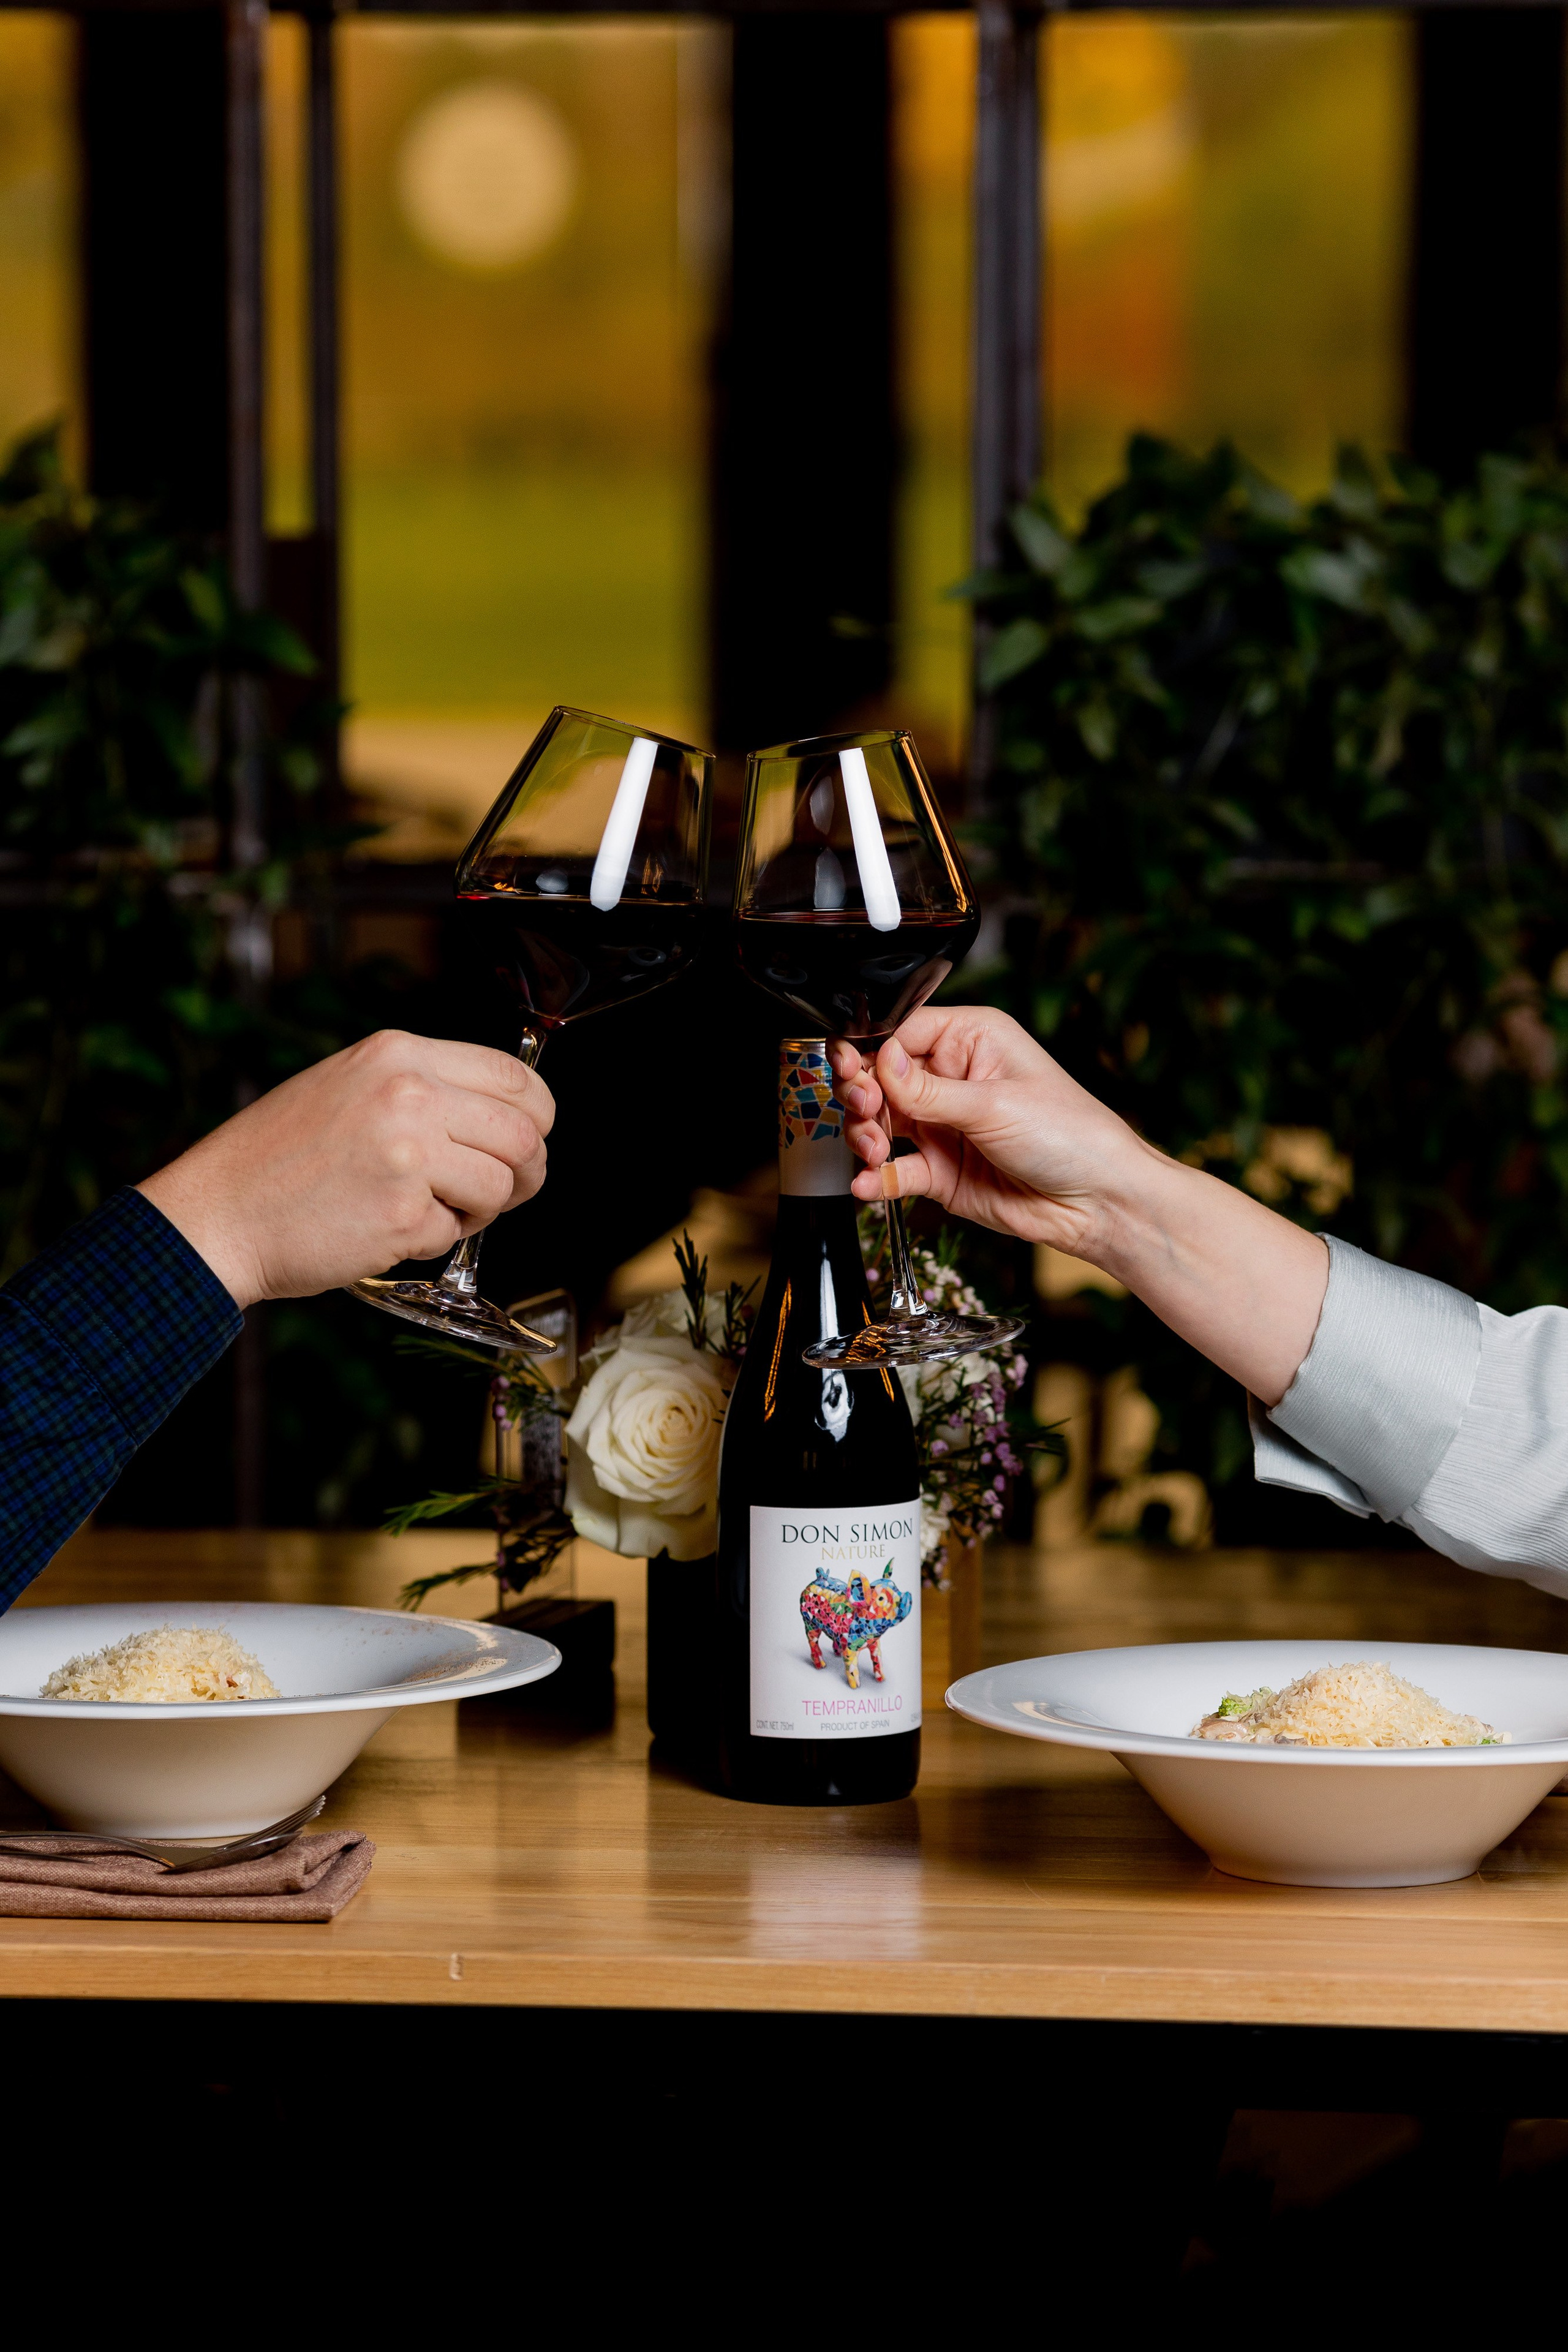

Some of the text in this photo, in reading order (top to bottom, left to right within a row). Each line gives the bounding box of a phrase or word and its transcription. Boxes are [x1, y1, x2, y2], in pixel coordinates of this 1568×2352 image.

[782, 1518, 913, 1544] DON SIMON
[821, 1544, 886, 1560] NATURE
[802, 1695, 902, 1716] TEMPRANILLO
[821, 1720, 890, 1731] PRODUCT OF SPAIN
